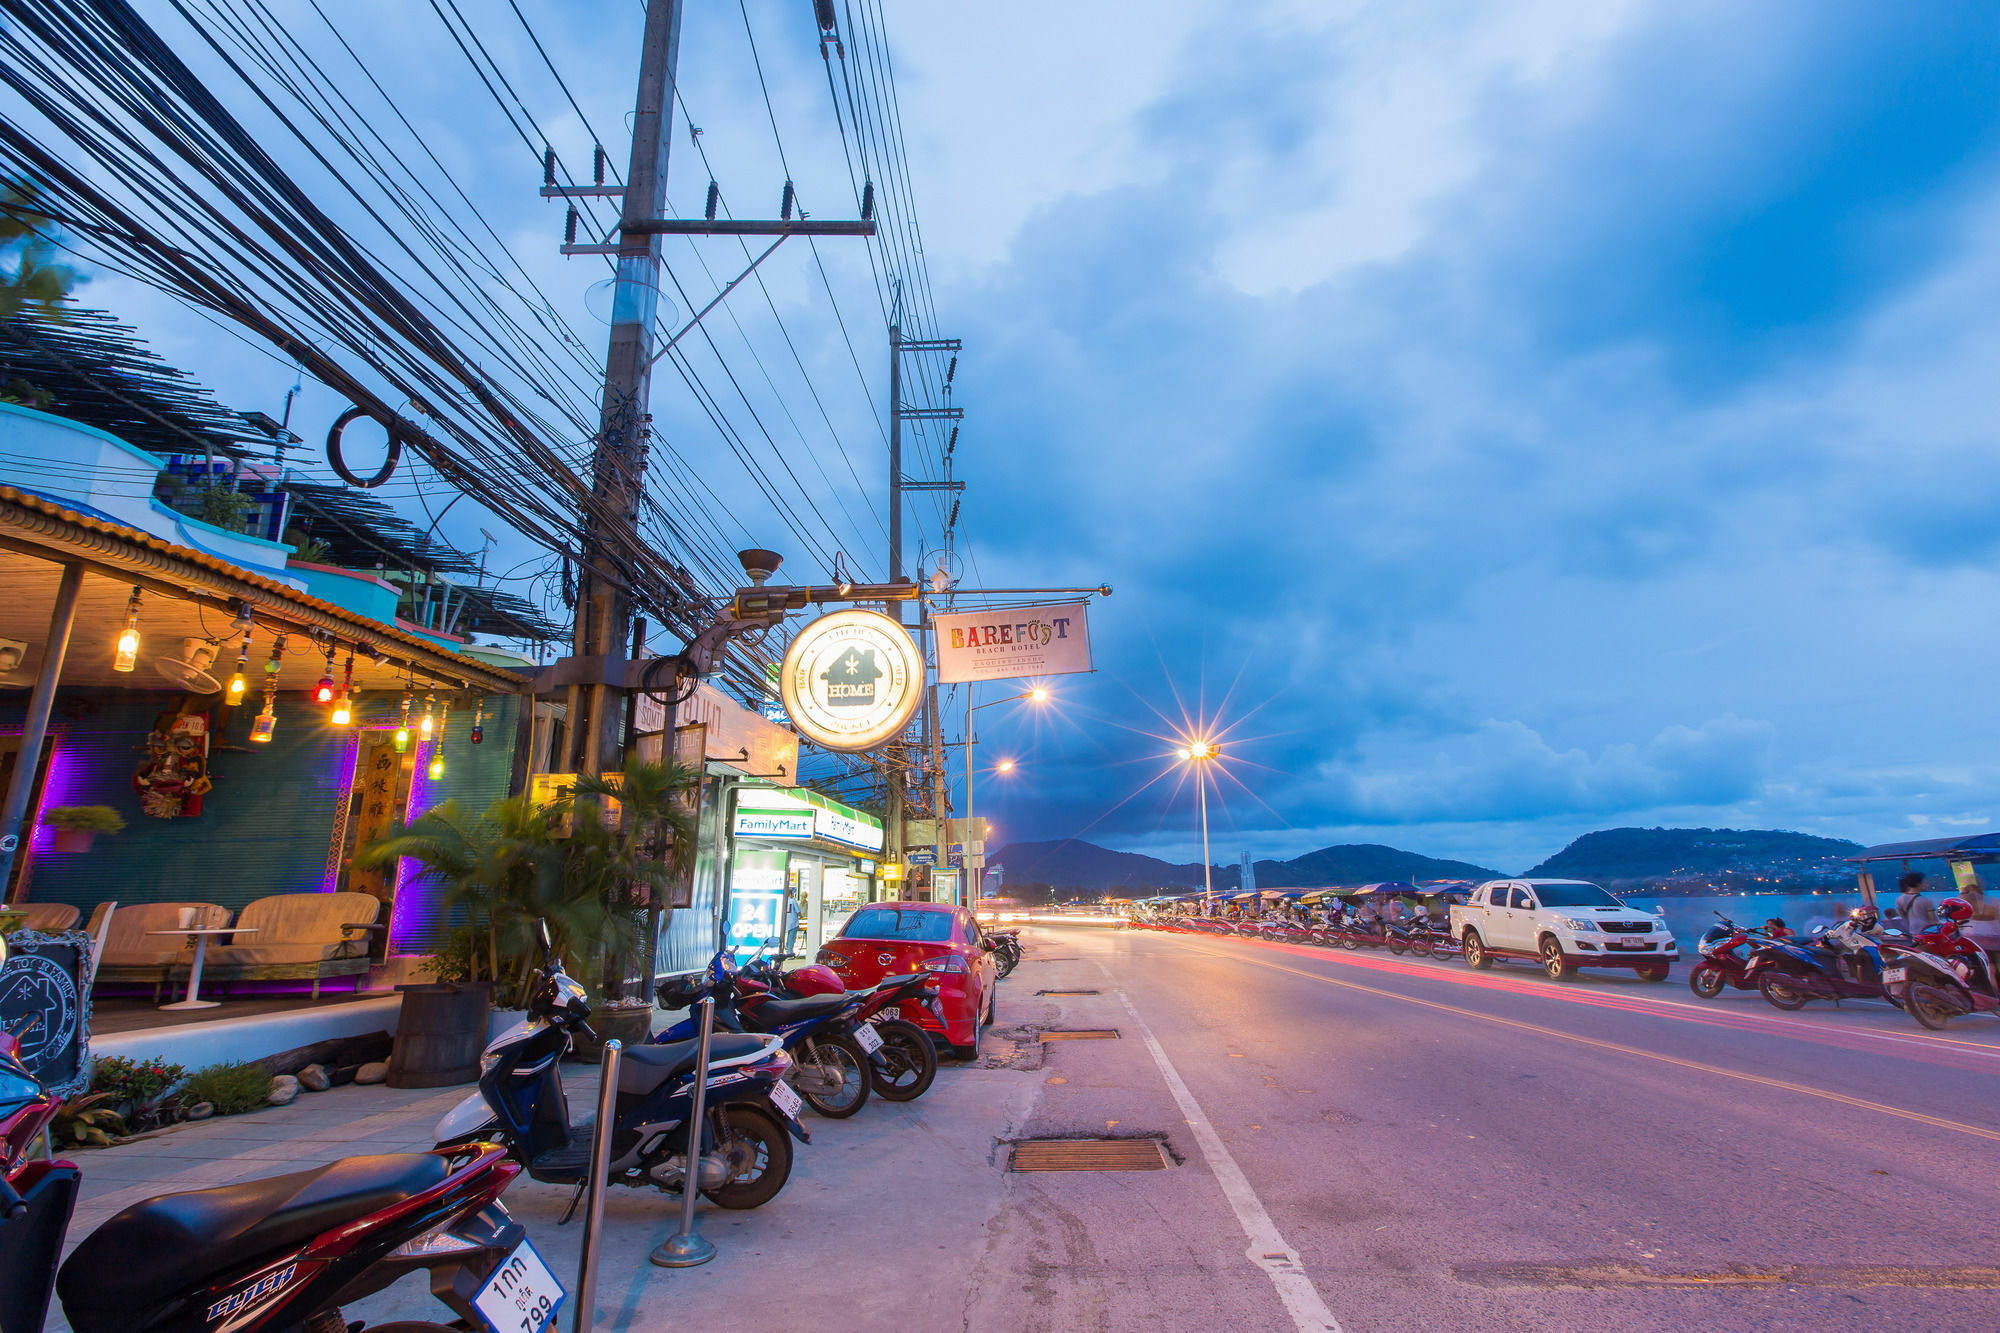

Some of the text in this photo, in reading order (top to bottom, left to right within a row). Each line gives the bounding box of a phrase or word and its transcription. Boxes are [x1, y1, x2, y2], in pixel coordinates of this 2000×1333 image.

[976, 642, 1041, 655] BEACH HOTEL
[828, 683, 873, 698] HOME
[740, 818, 807, 831] FamilyMart
[743, 904, 765, 921] 24
[731, 922, 774, 938] OPEN
[50, 966, 74, 999] FAMILY
[493, 1256, 528, 1300] 1กก
[206, 1262, 298, 1322] CLICK
[520, 1295, 553, 1333] 799
